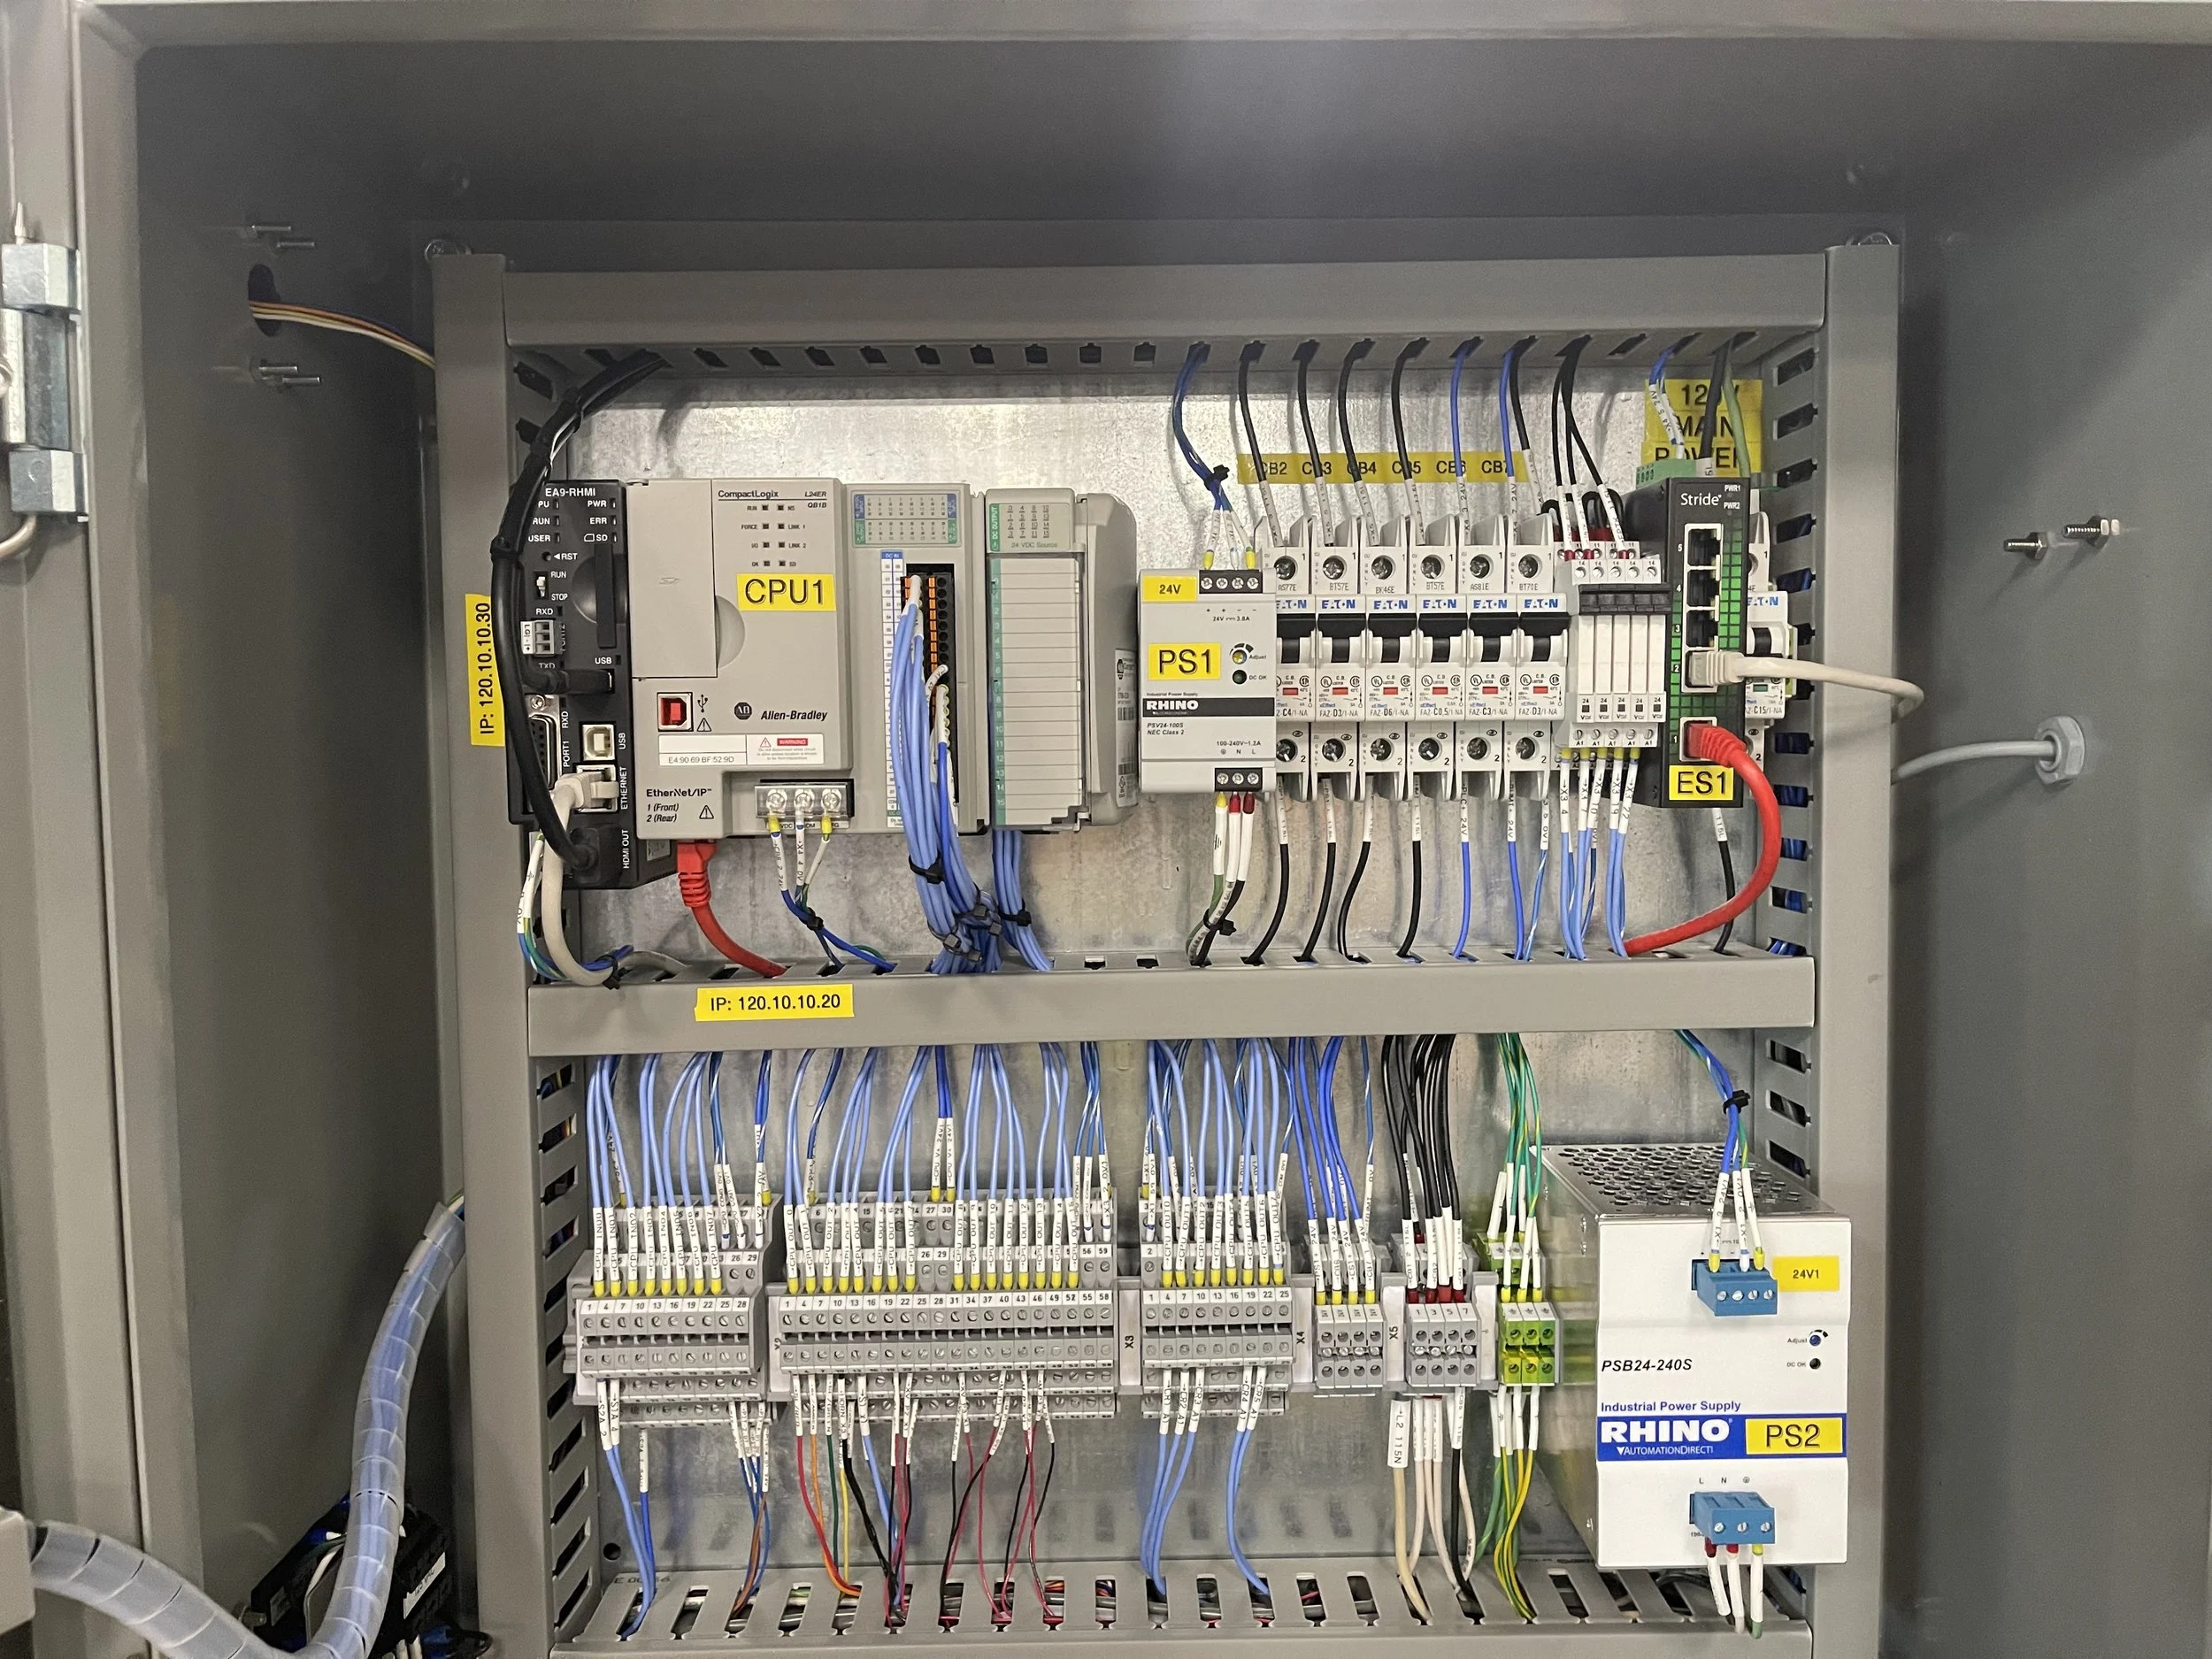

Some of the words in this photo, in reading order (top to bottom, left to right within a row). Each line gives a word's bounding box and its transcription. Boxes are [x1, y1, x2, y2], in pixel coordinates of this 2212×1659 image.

[1392, 461, 1421, 474] C5
[545, 488, 596, 497] EA9-RHMI
[718, 489, 779, 499] CompactLogix
[1681, 493, 1718, 506] Stride
[745, 579, 823, 604] CPU1
[1159, 584, 1181, 595] 24V
[476, 603, 493, 707] 120.10.10.30
[1159, 649, 1210, 674] PS1
[1147, 700, 1199, 710] RHINO
[761, 710, 827, 721] Allen-Bradley
[480, 713, 495, 733] IP:
[1678, 772, 1725, 794] ES1
[654, 814, 677, 823] (Rear)
[711, 998, 731, 1010] IP:
[739, 995, 840, 1010] 120.10.10.20
[1793, 1270, 1819, 1279] 24V1
[1296, 1332, 1305, 1344] X4
[1389, 1326, 1398, 1340] X5
[1125, 1335, 1133, 1348] X3
[1601, 1359, 1692, 1371] PSB24-240S
[1601, 1402, 1656, 1412] Industrial
[1660, 1402, 1697, 1410] Power
[1701, 1402, 1741, 1412] Supply
[1601, 1419, 1730, 1442] RHINO
[1766, 1425, 1819, 1448] PS2
